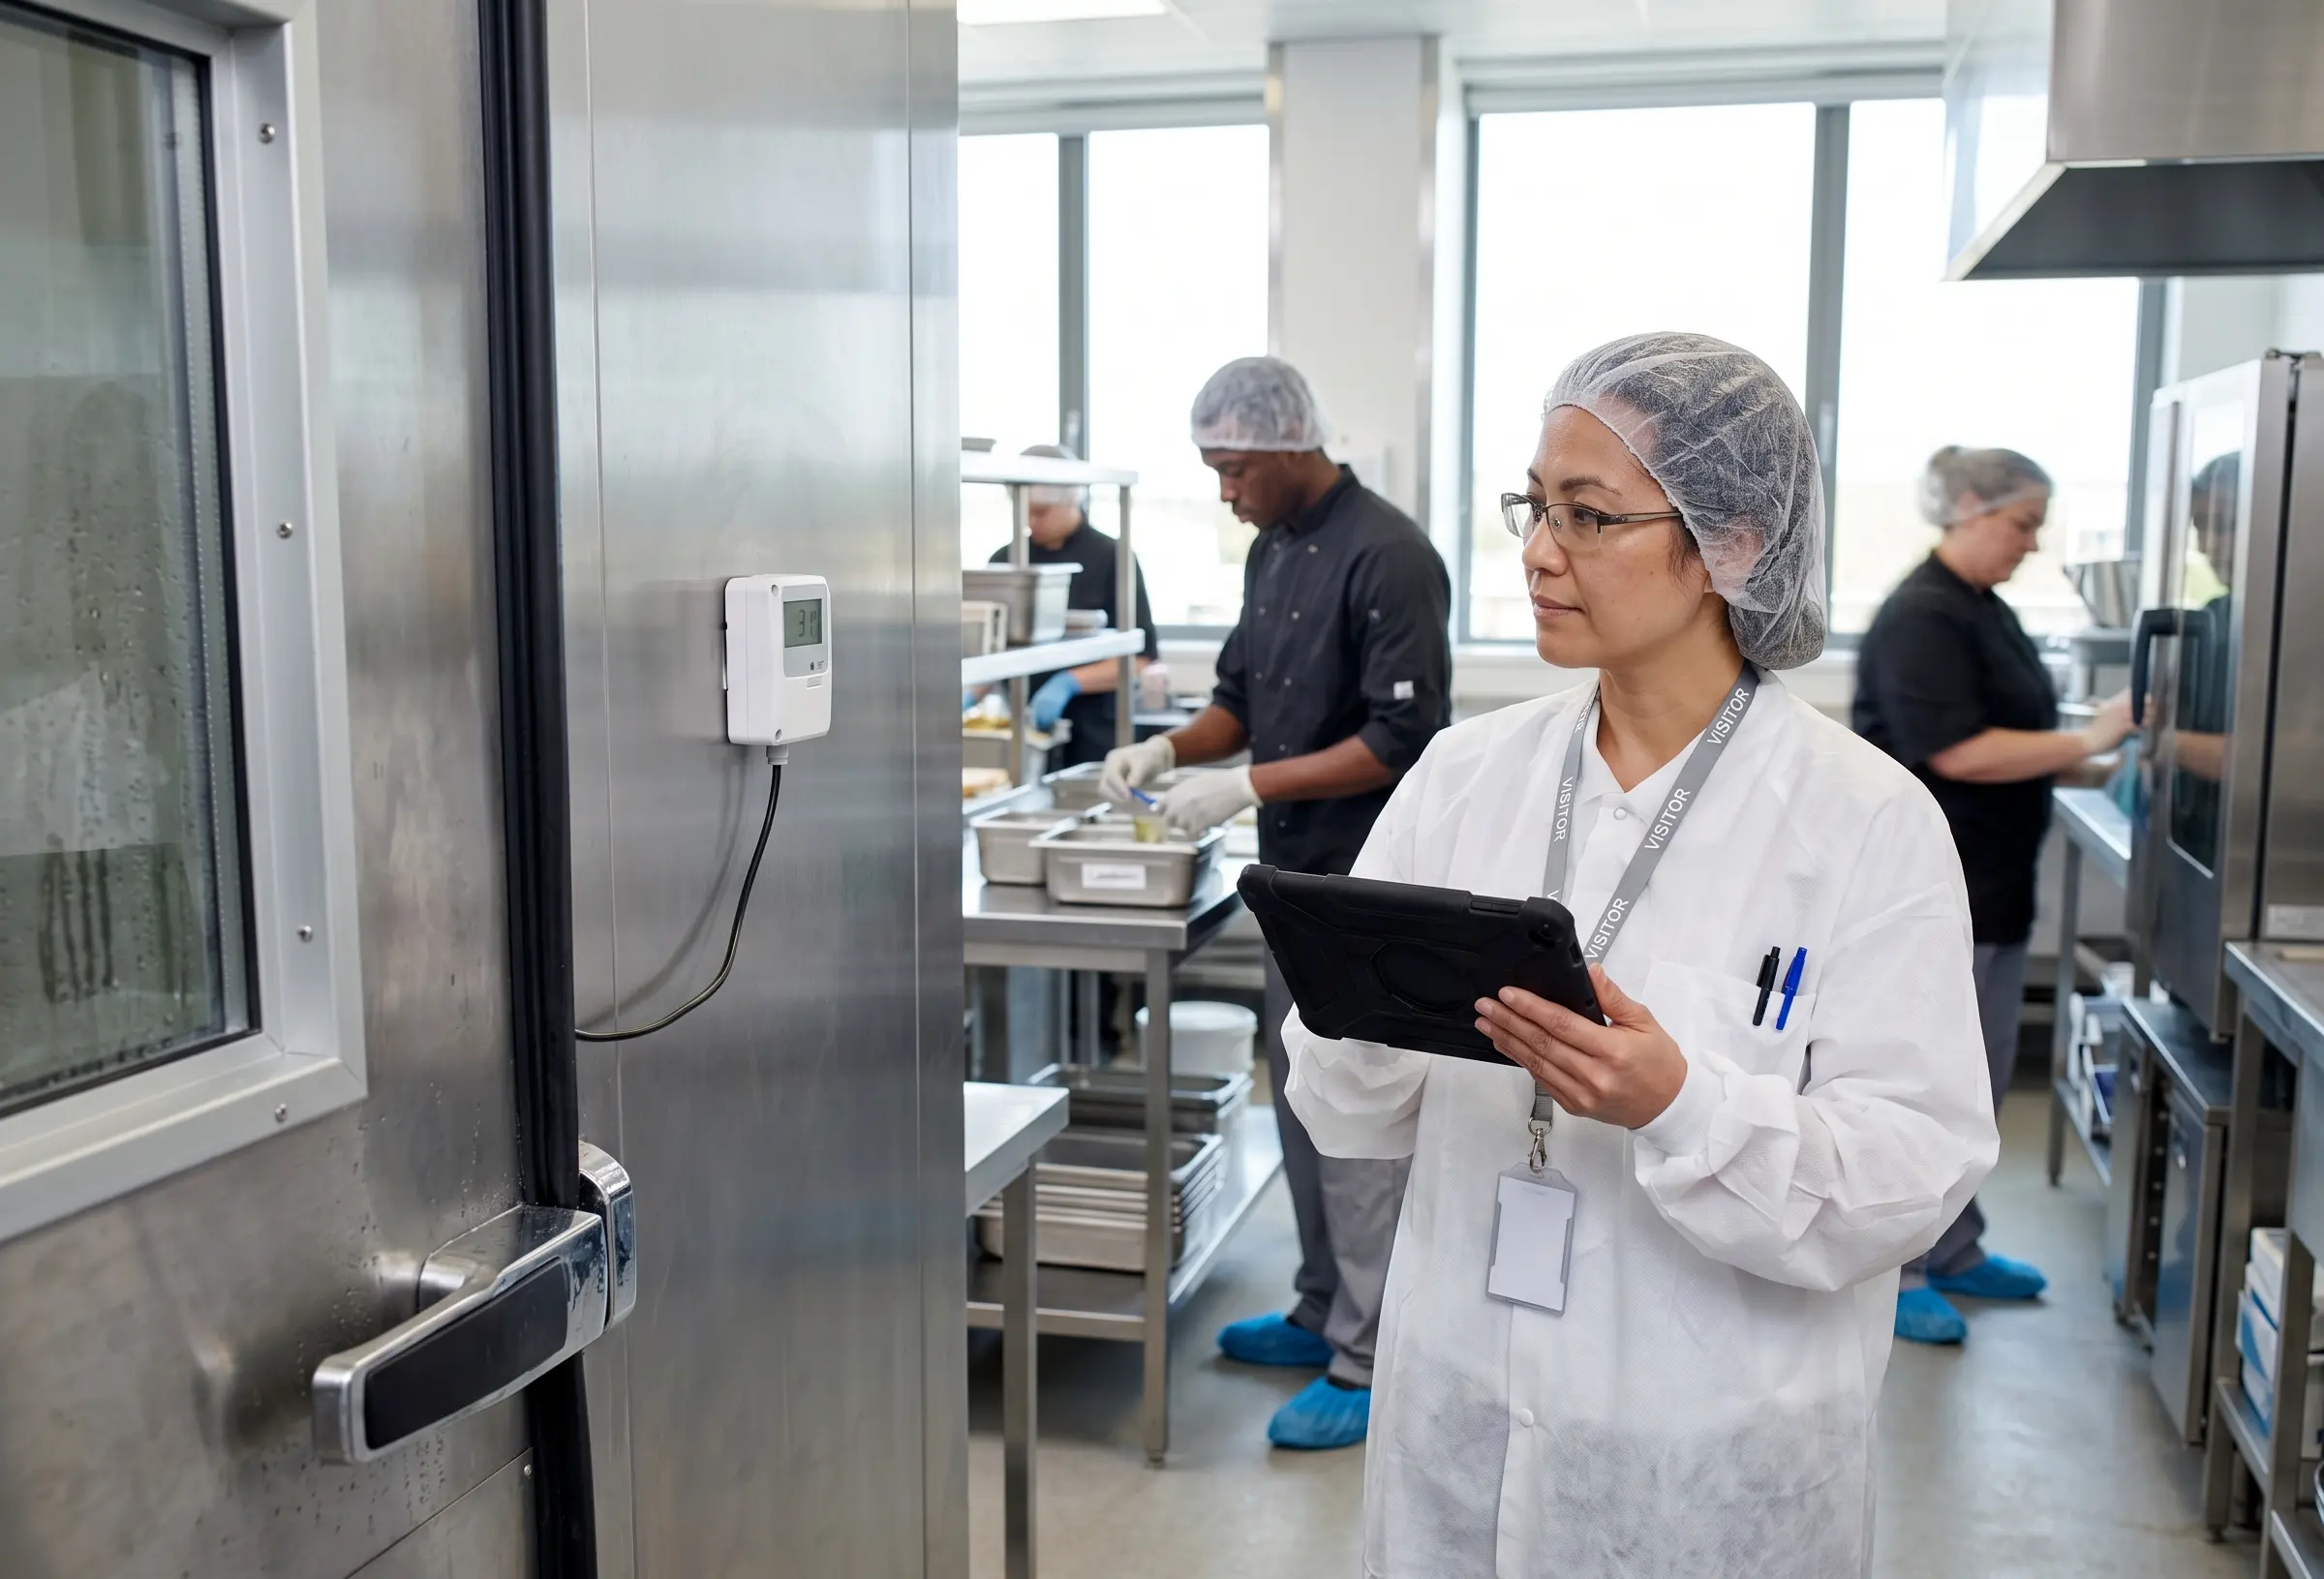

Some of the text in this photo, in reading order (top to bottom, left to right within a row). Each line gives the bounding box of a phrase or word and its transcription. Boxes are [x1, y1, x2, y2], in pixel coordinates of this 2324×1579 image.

[1707, 687, 1750, 744] VISITOR
[1554, 776, 1574, 842] VISITOR
[1644, 788, 1691, 850] VISITOR
[1584, 897, 1629, 958] VISITOR
